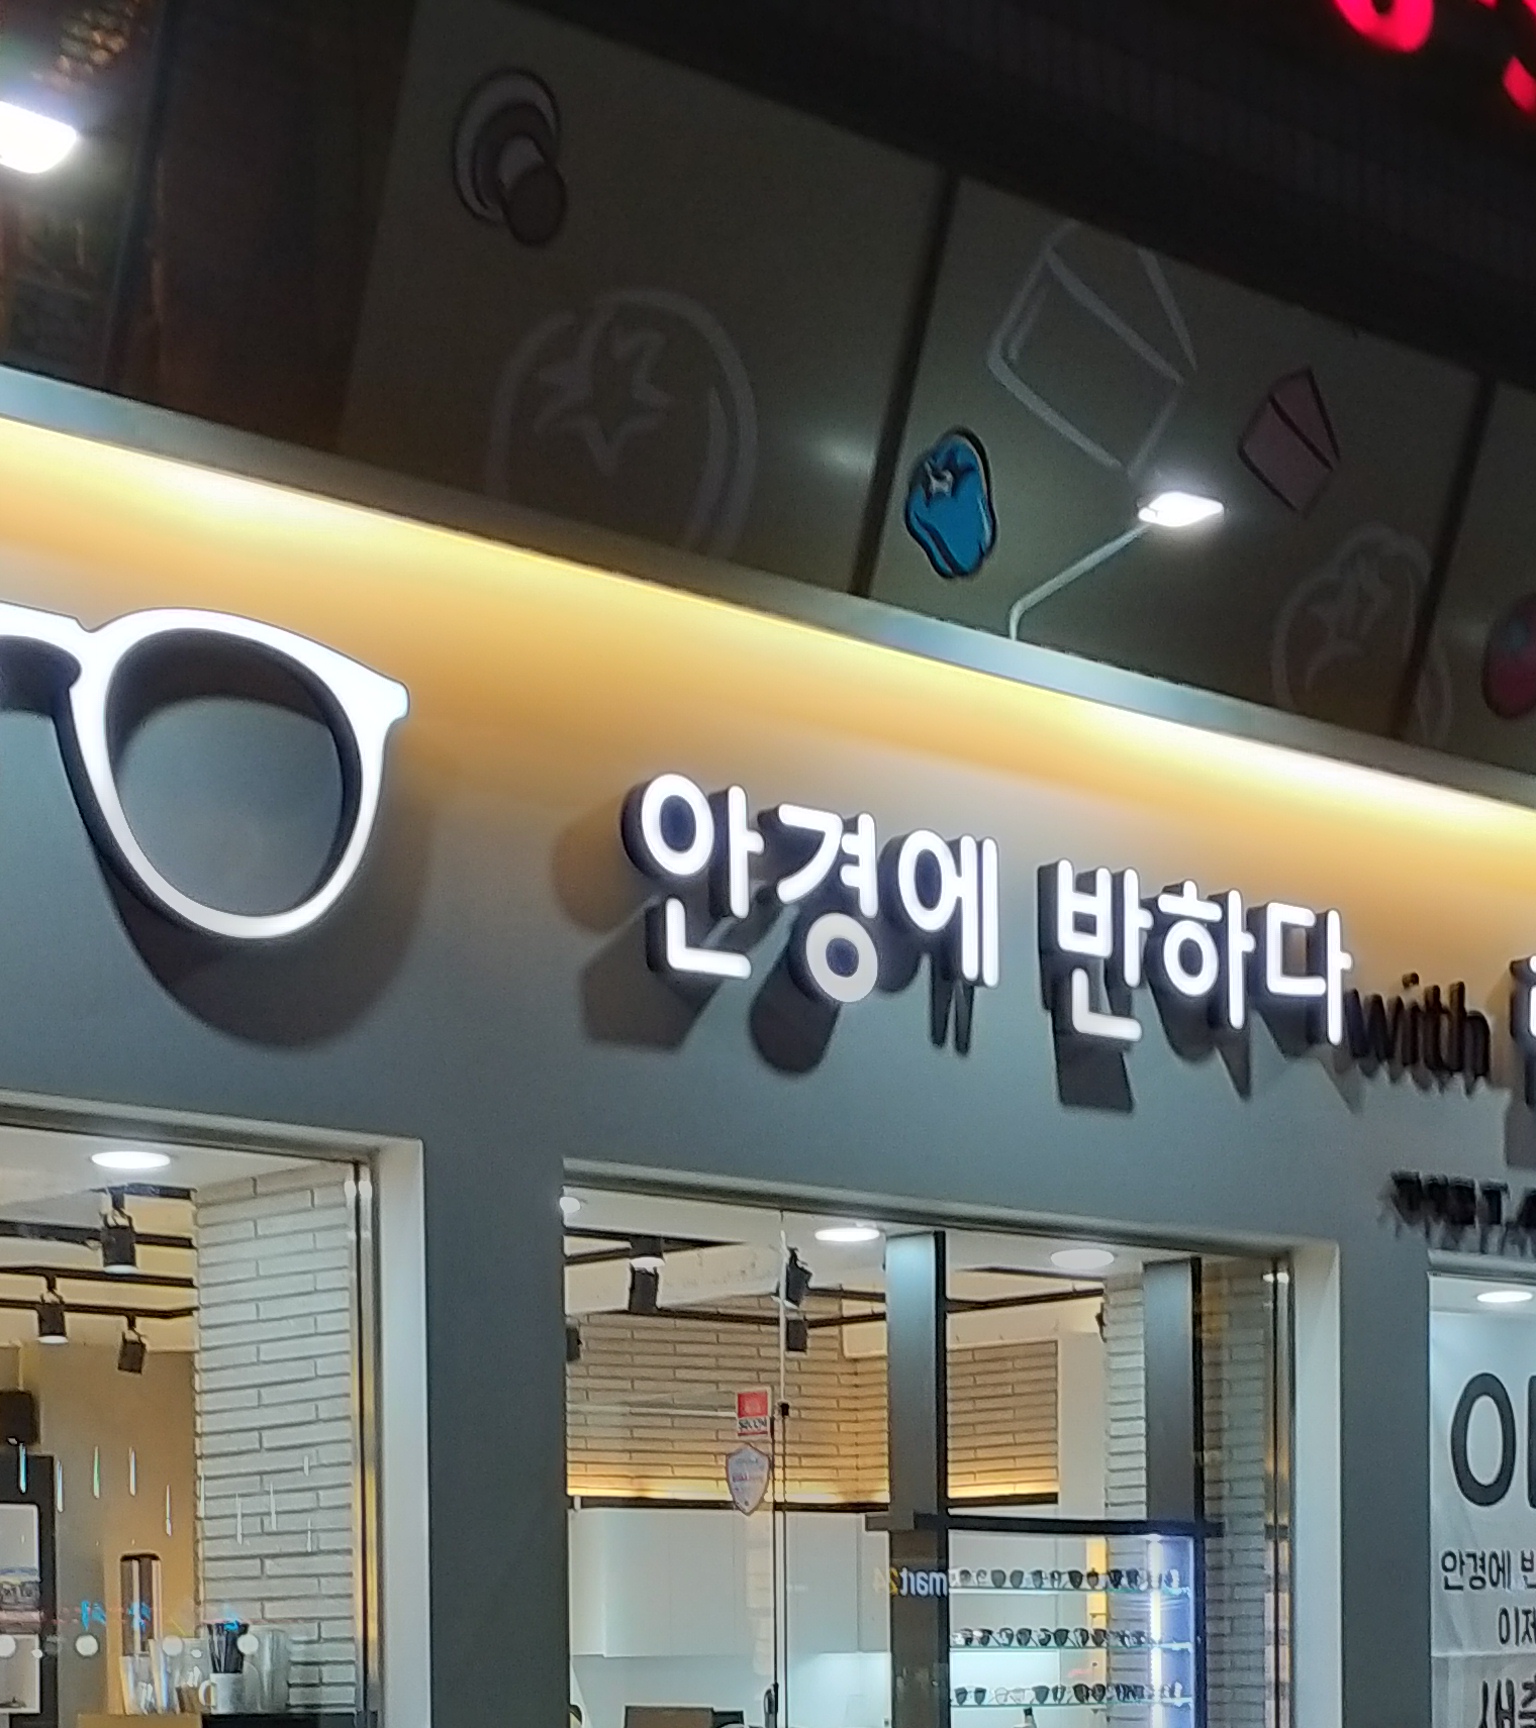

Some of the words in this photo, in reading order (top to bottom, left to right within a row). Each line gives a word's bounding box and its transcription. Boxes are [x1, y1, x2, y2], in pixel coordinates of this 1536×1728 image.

[629, 772, 1002, 1006] 안경에
[1046, 858, 1353, 1050] 반하다
[1345, 972, 1492, 1079] with
[1440, 1547, 1513, 1591] 안경에
